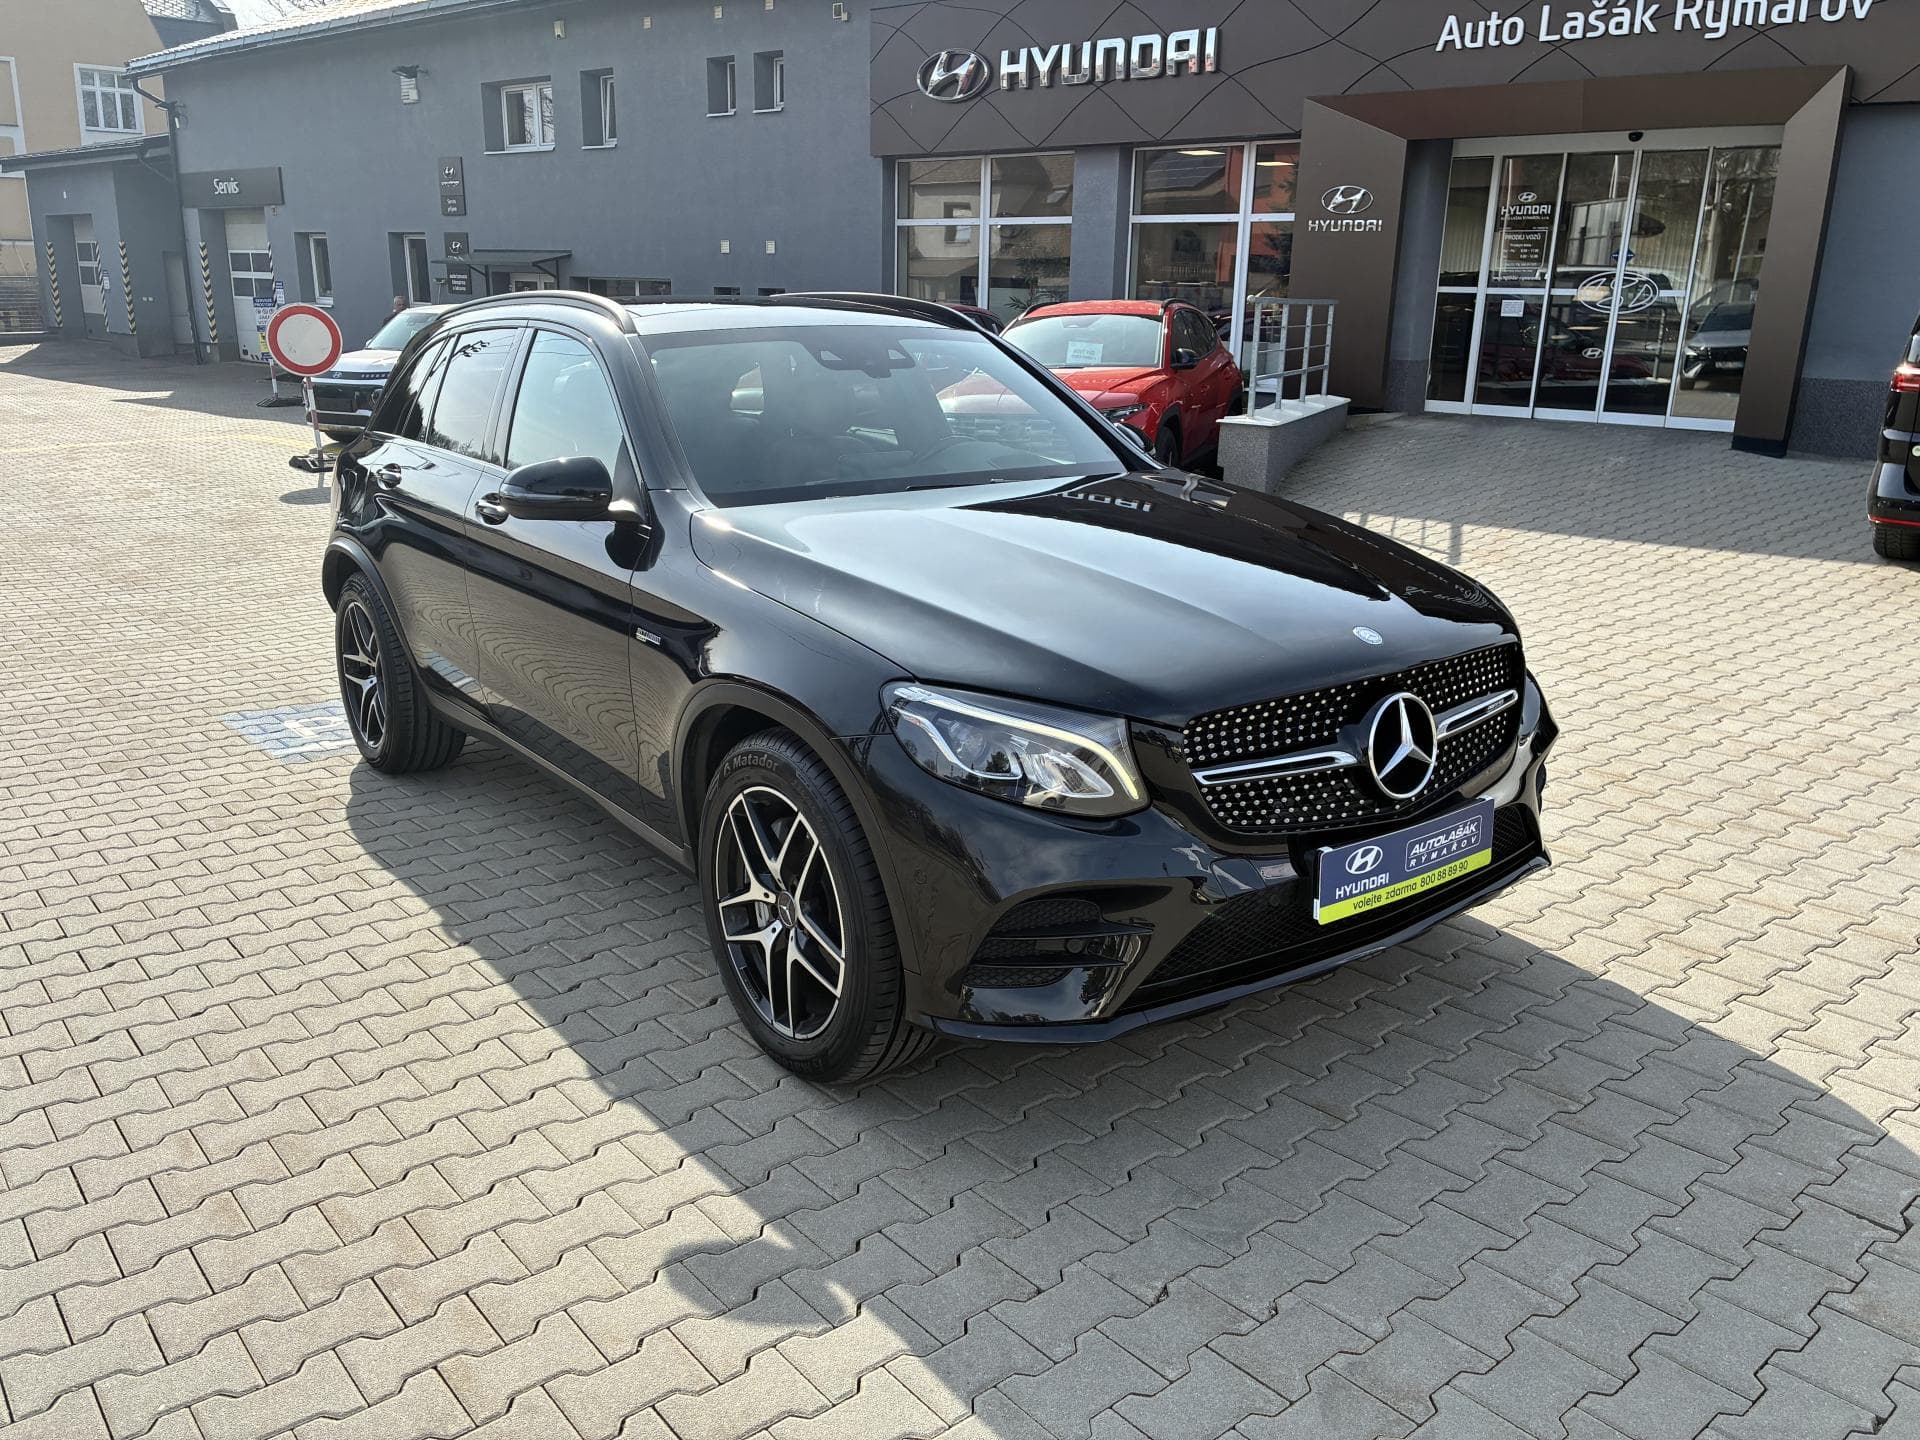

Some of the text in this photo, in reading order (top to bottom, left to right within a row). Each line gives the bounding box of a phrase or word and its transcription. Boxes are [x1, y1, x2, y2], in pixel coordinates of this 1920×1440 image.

[1435, 11, 1525, 52] Auto
[1538, 0, 1660, 42] Lašák
[1000, 27, 1217, 90] HYUNDAI
[213, 177, 240, 195] Servis
[1500, 204, 1552, 215] HYUNDAI
[1308, 219, 1383, 232] HYUNDAI
[733, 753, 780, 773] Matador
[1410, 821, 1478, 856] AUTOLAŠÁK
[1335, 872, 1390, 900] HYUNDAI
[1353, 860, 1469, 910] volejte zdarma 800 88 89 90
